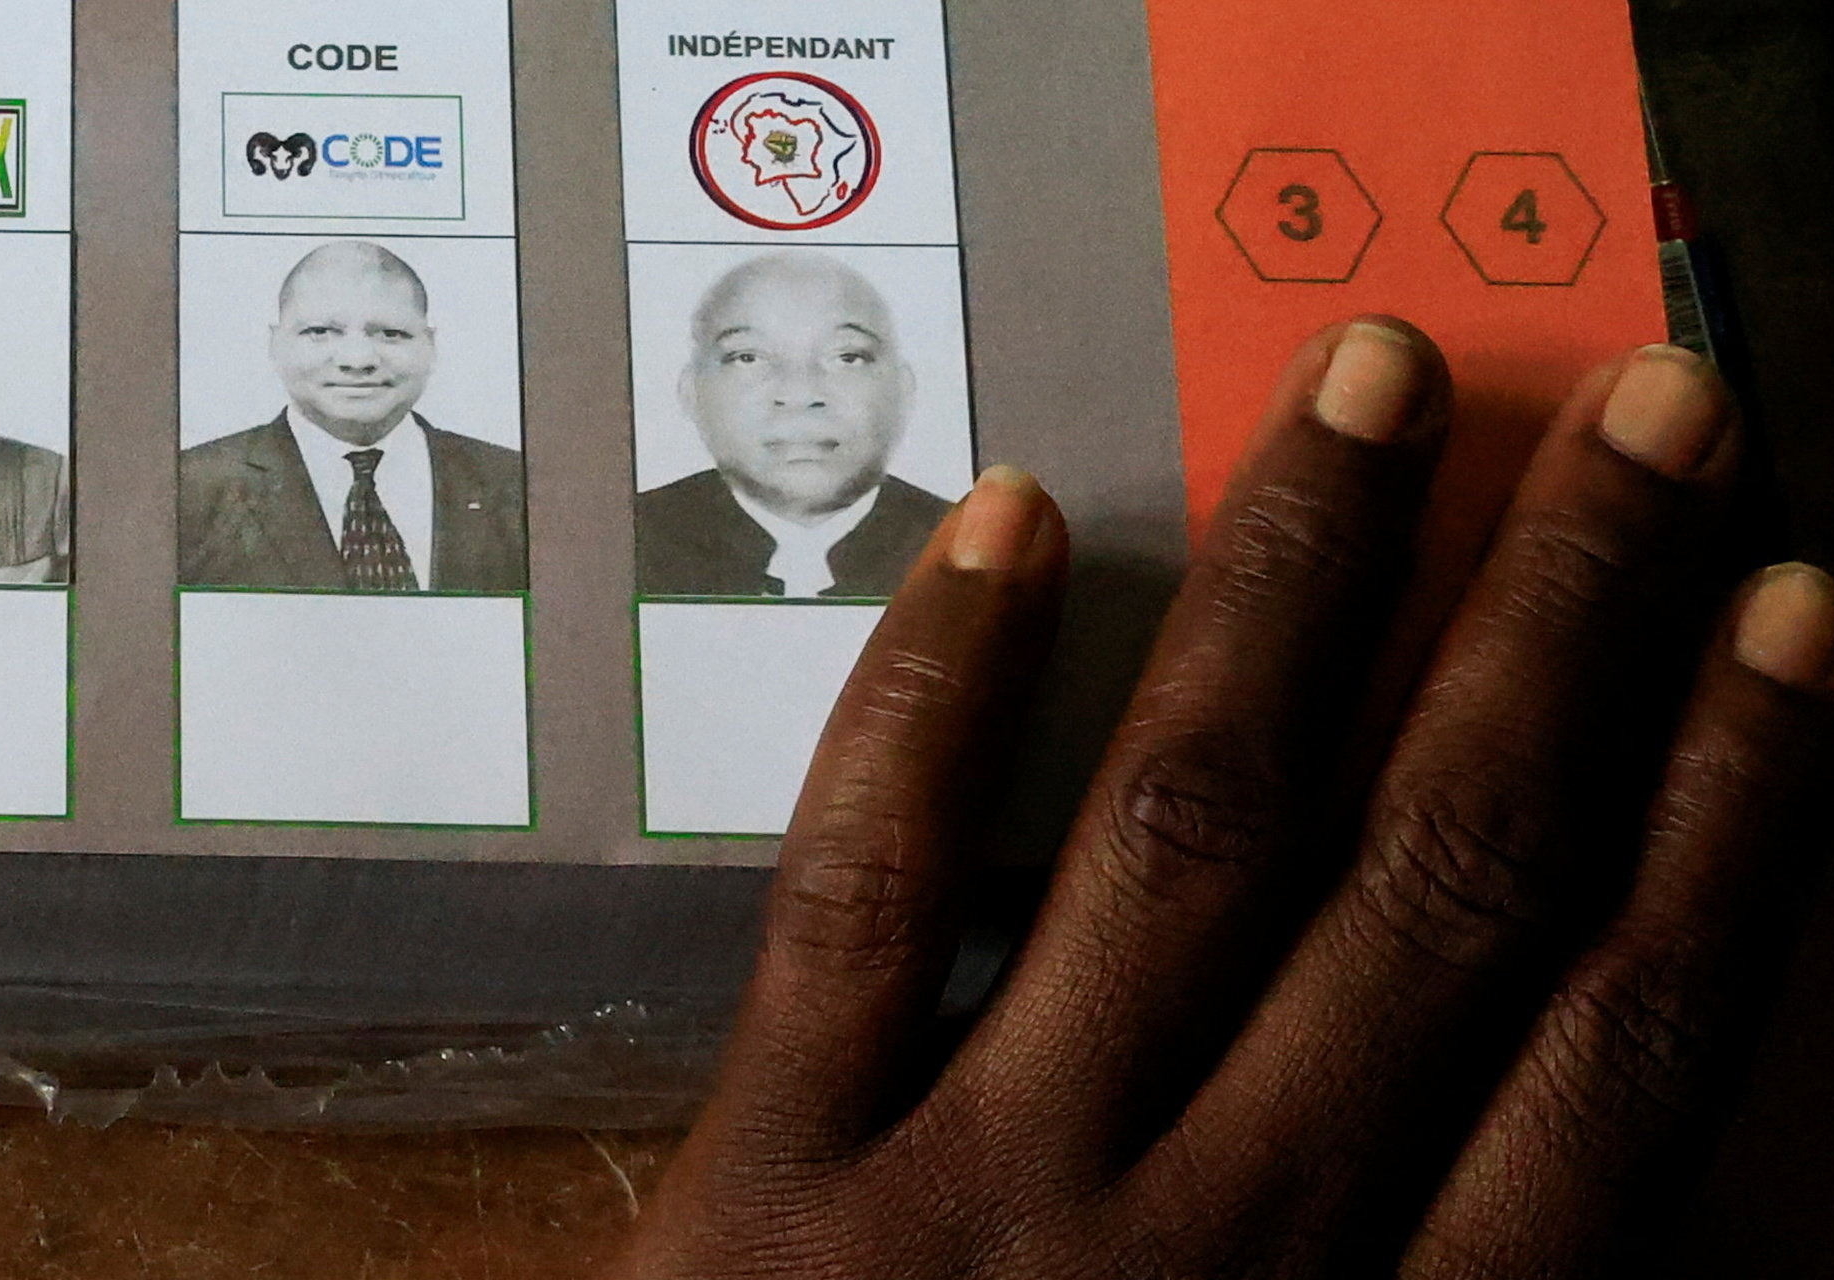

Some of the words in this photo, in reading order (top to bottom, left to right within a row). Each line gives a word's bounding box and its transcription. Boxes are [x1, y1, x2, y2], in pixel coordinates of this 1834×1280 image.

[287, 43, 399, 71] CODE
[668, 29, 896, 61] INDÉPENDANT
[322, 133, 443, 168] CODE
[1276, 183, 1324, 242] 3
[1499, 188, 1548, 245] 4
